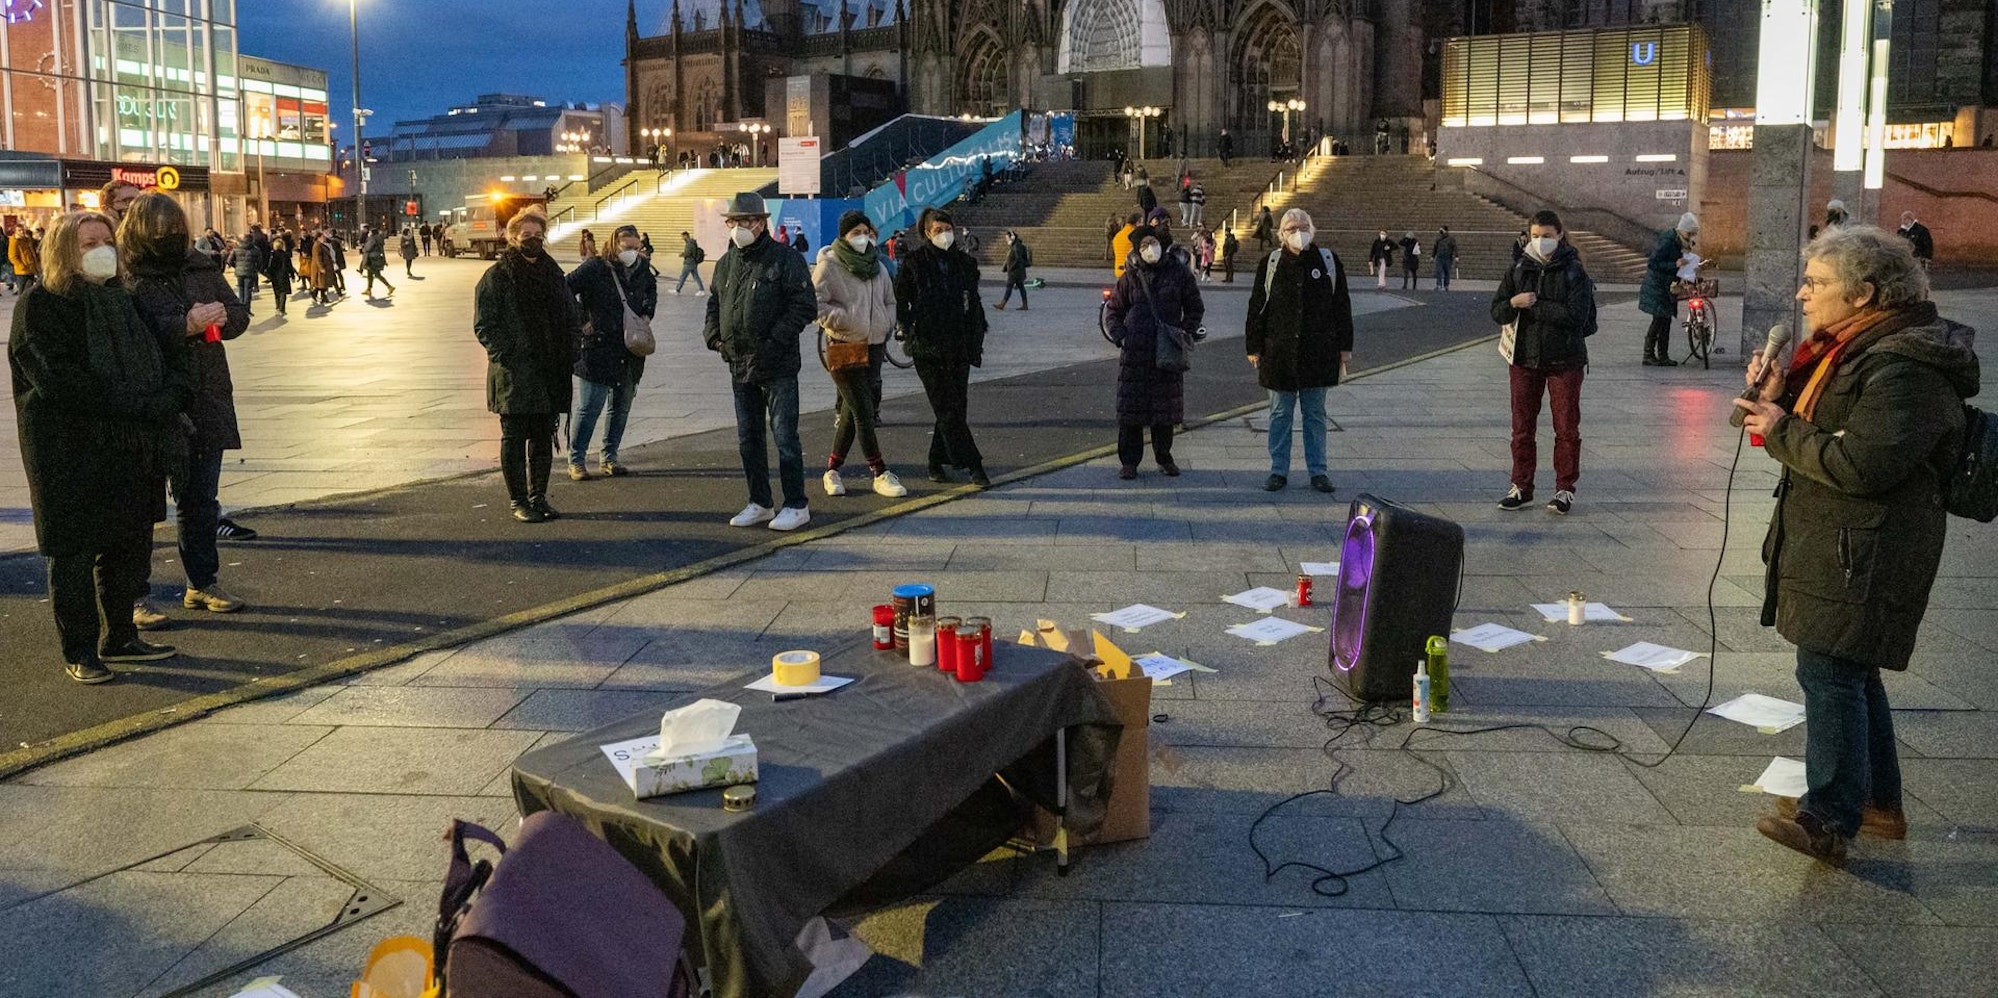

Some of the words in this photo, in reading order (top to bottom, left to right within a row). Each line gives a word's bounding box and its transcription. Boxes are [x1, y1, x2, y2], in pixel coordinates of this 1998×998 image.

[1632, 42, 1655, 66] U
[245, 63, 271, 75] PRADA
[111, 168, 156, 187] Kamps
[875, 194, 909, 224] VIA
